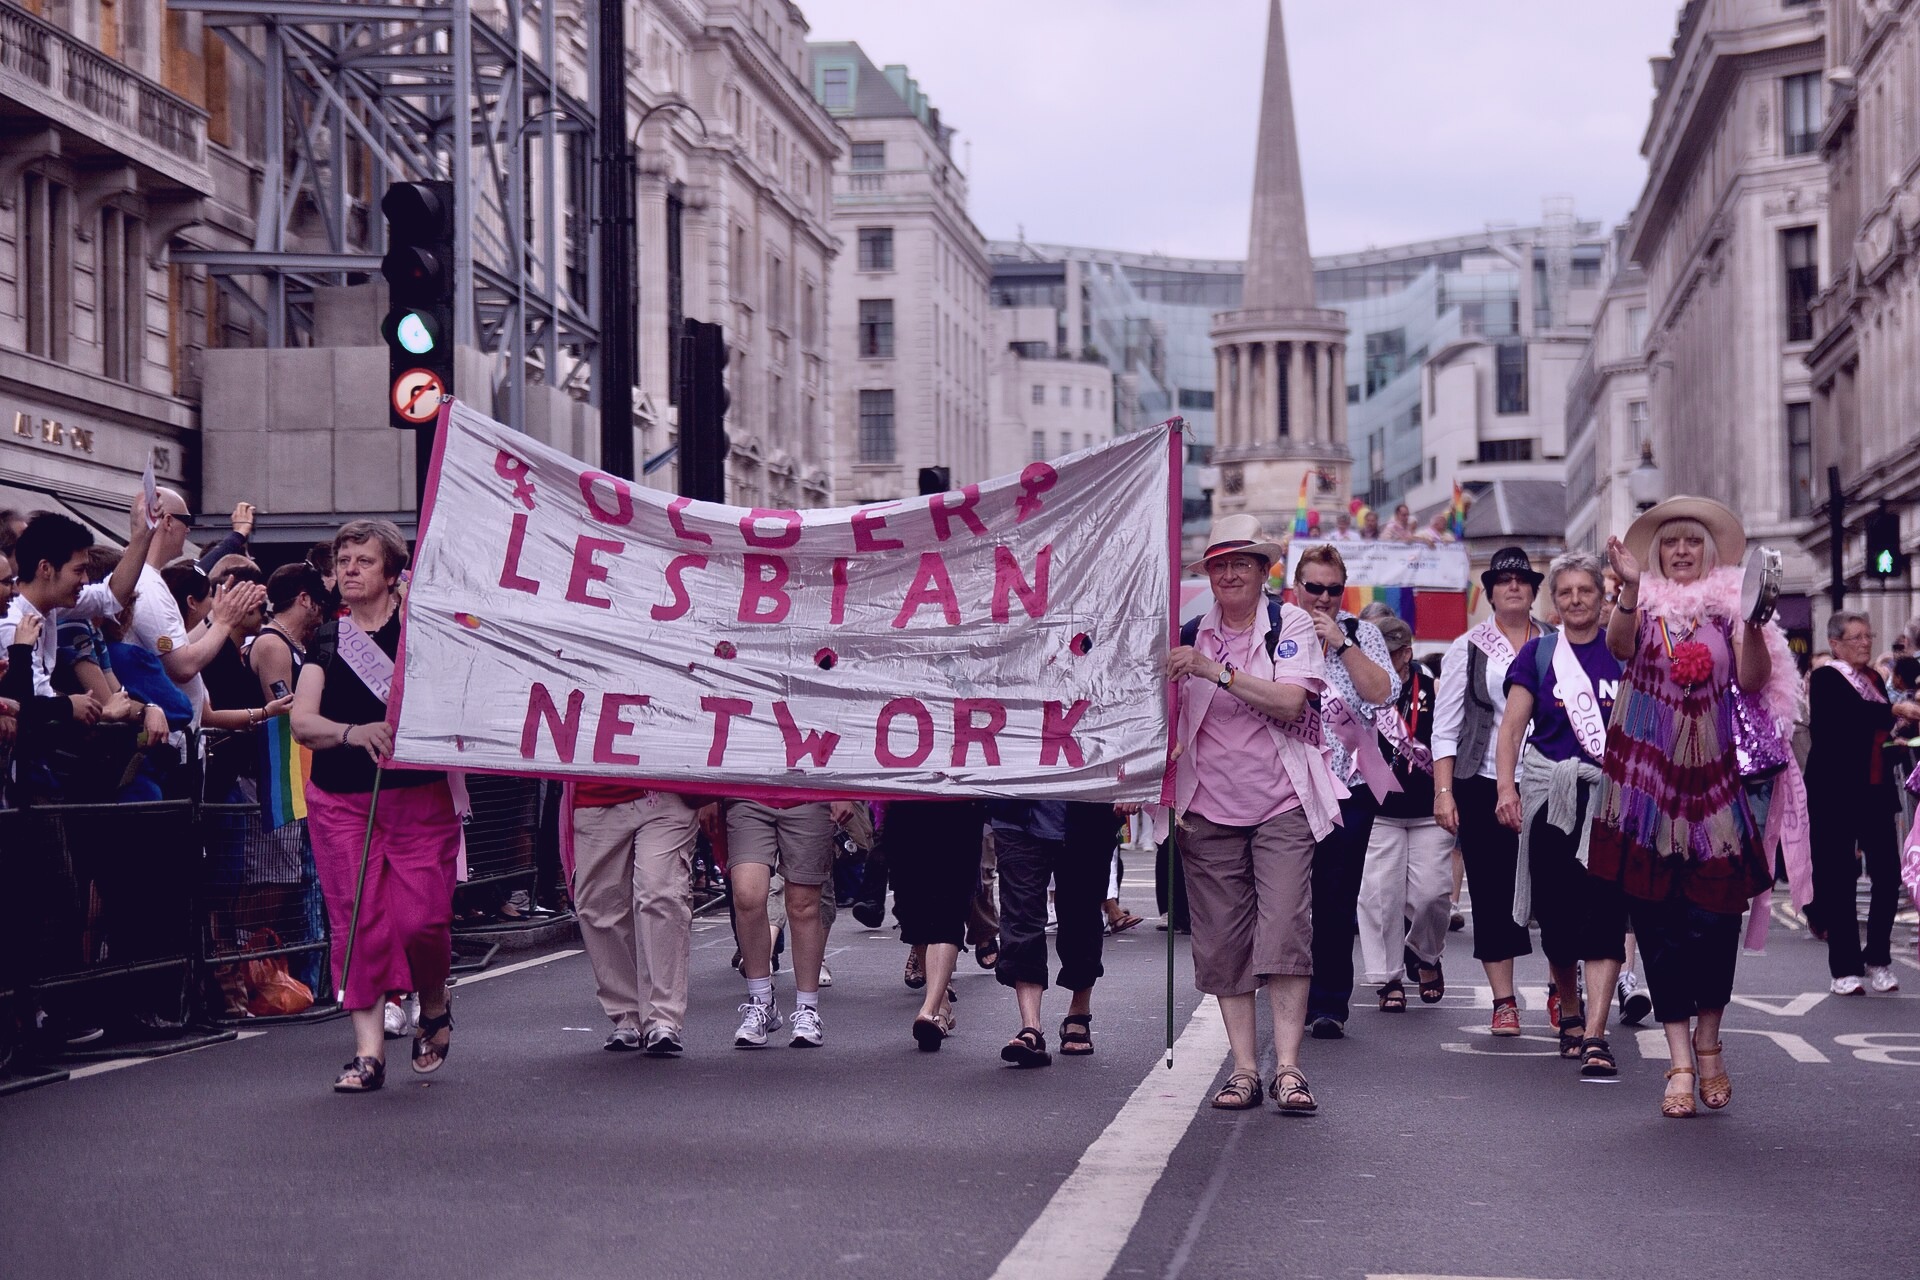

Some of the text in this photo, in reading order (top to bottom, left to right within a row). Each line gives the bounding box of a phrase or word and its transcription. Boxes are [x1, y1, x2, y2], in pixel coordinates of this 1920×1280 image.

[579, 470, 988, 552] OLDER
[499, 512, 1053, 628] LESBIAN
[520, 682, 1091, 768] NETWORK
